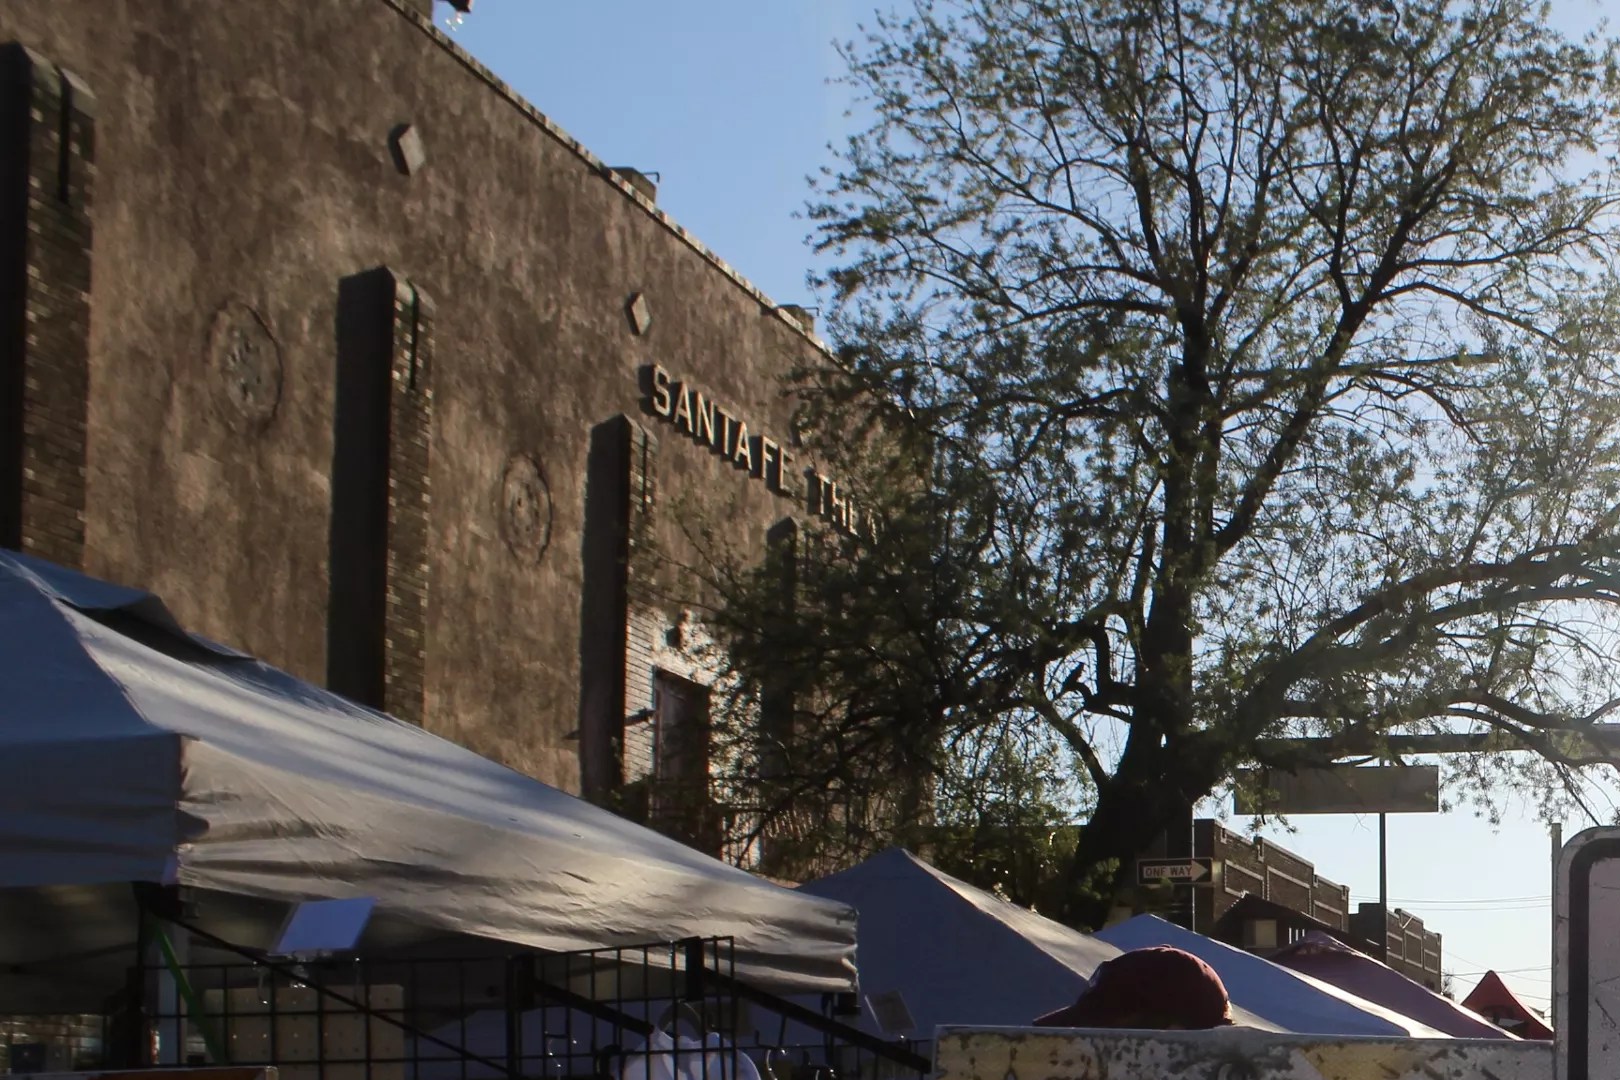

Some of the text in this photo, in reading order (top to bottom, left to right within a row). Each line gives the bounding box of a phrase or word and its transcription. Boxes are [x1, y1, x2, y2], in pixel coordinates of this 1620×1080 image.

[653, 363, 752, 470] SANTA
[760, 436, 796, 498] FE
[1169, 866, 1193, 876] WAY
